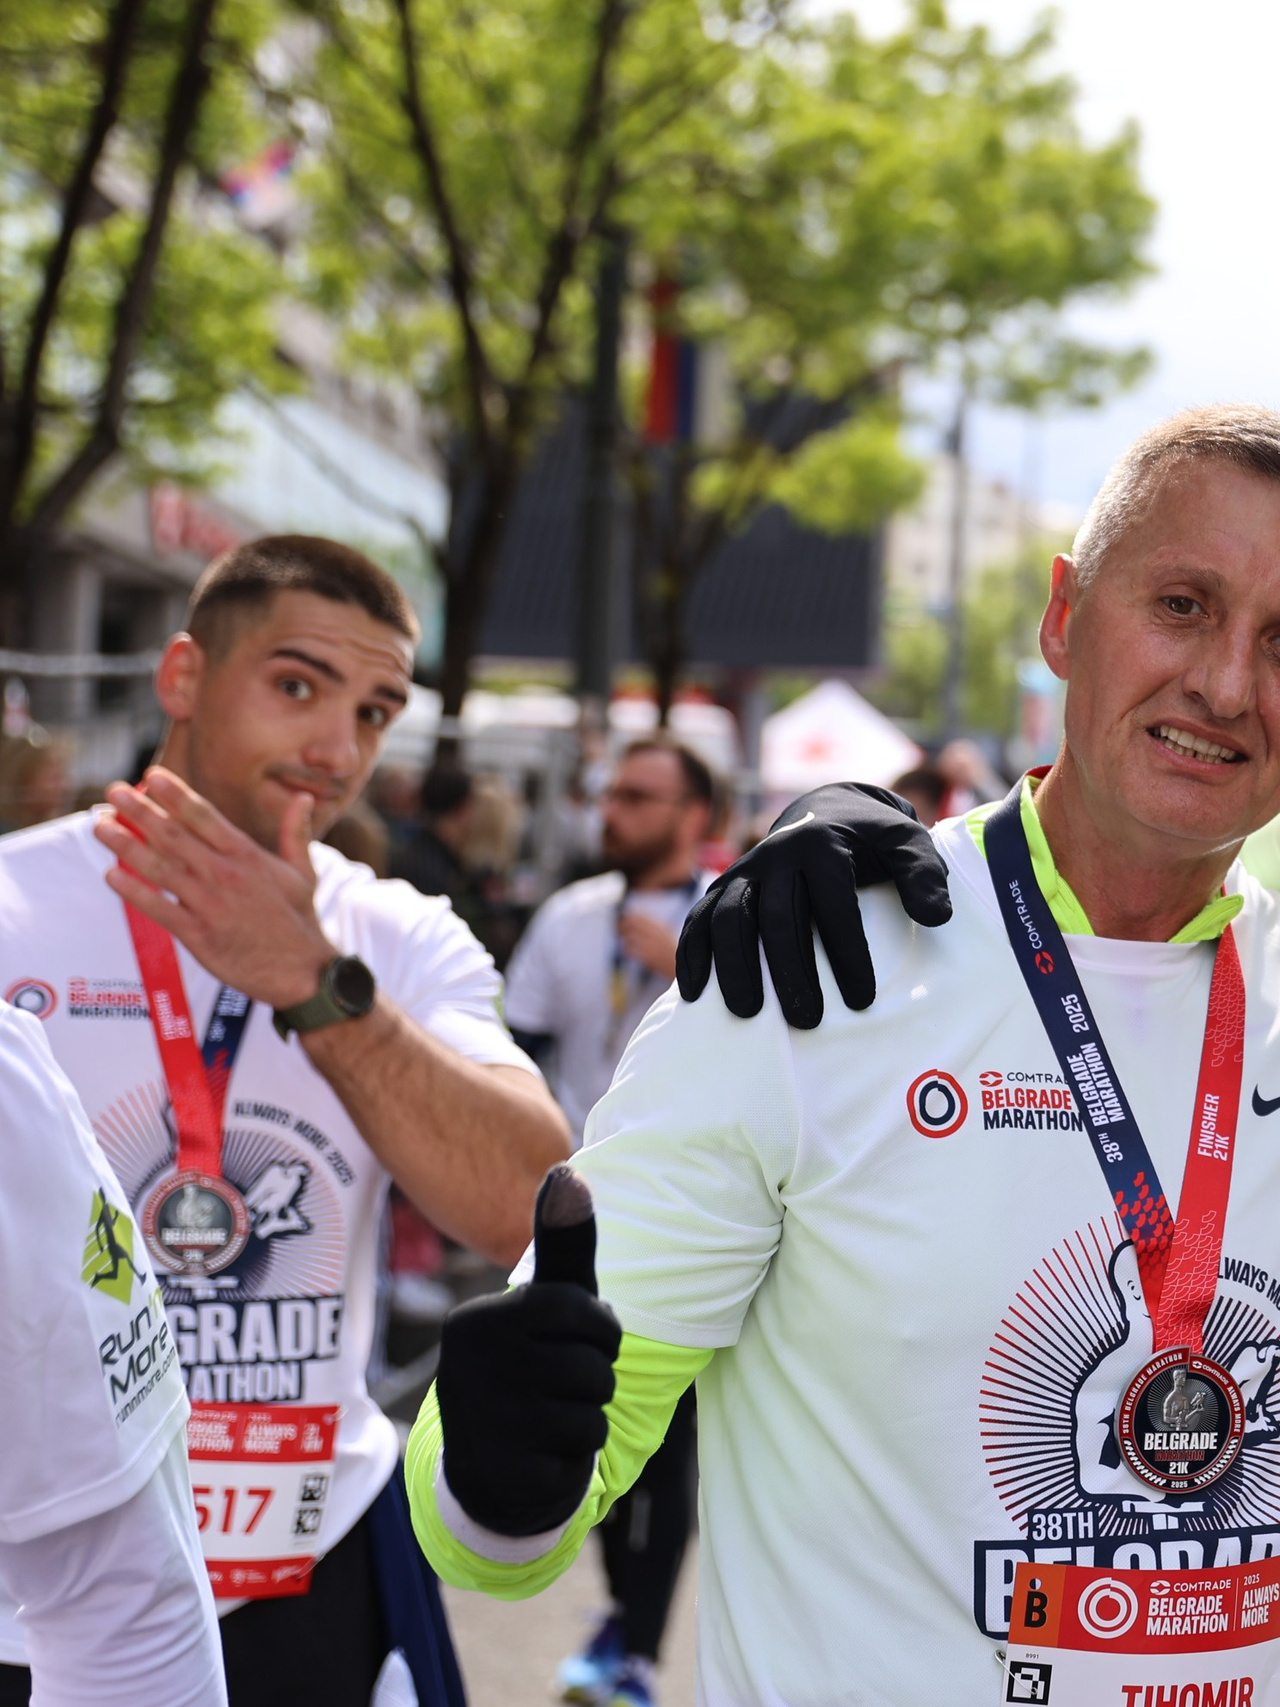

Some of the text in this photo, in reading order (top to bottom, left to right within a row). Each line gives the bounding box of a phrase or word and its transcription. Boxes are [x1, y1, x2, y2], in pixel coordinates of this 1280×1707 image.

[1009, 879, 1043, 950] COMTRADE
[1061, 994, 1126, 1123] MARATHON 2025
[1006, 1072, 1069, 1084] COMTRA
[1067, 1054, 1109, 1127] BELGRADE
[981, 1087, 1073, 1110] BELGRADE
[983, 1108, 1083, 1132] MARATHON
[1197, 1093, 1220, 1157] FINISHER
[1213, 1133, 1230, 1161] 21K
[1217, 1256, 1268, 1293] LWAYS
[164, 1297, 342, 1364] GRADE
[110, 1321, 168, 1405] More
[1146, 1352, 1183, 1376] MARATHON
[188, 1362, 300, 1403] ATHON
[1144, 1432, 1219, 1450] BELGRADE
[1169, 1461, 1189, 1474] 21K
[1032, 1511, 1094, 1541] 38TH
[1173, 1579, 1231, 1593] COMTRADE
[1243, 1573, 1260, 1587] 2025
[1024, 1590, 1049, 1628] B
[1149, 1594, 1223, 1616] BELGRADE
[1242, 1584, 1280, 1609] ALWAYS
[1146, 1613, 1228, 1636] MARATHON
[1240, 1606, 1269, 1629] MORE
